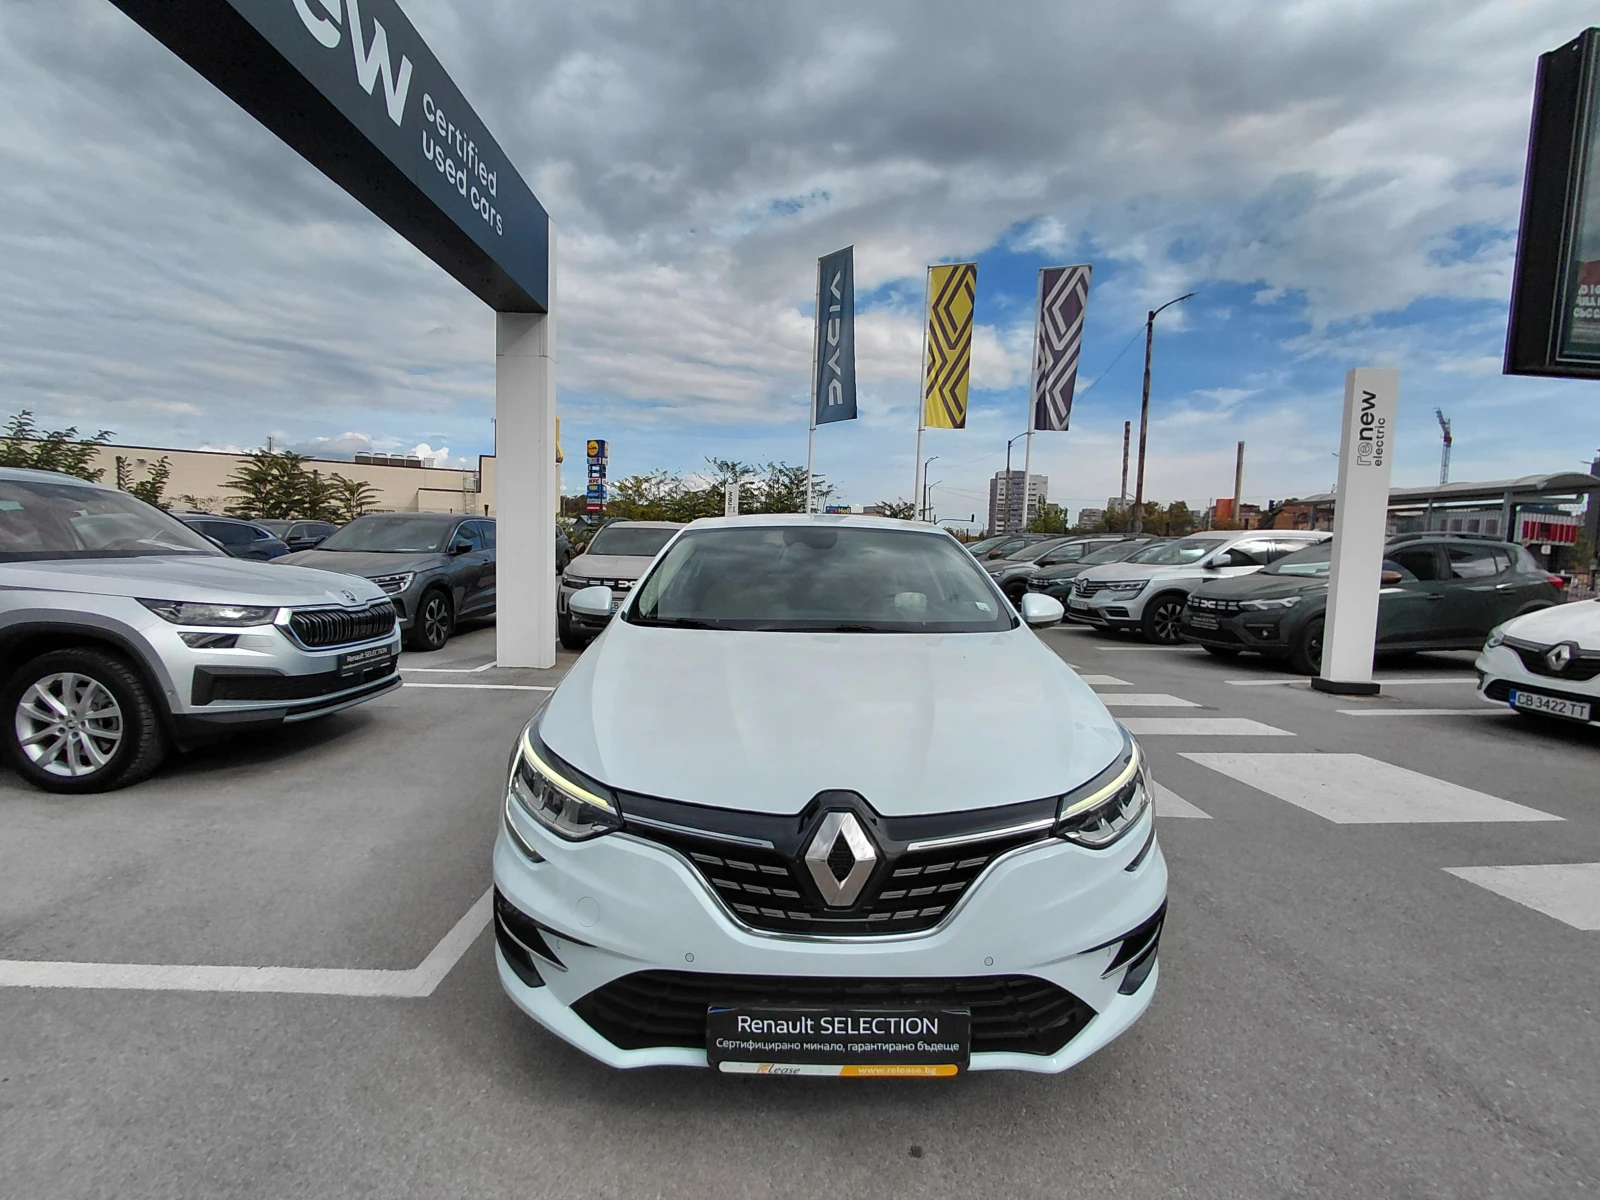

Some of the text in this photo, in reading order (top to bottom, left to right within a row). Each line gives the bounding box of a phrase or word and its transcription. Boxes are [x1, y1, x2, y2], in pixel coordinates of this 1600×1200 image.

[422, 92, 497, 198] certified
[422, 130, 503, 236] used cars
[1357, 390, 1377, 467] renew
[1373, 417, 1386, 467] electric
[346, 653, 364, 662] Renault
[365, 647, 388, 658] SELECTION
[1518, 694, 1586, 717] CB 3422 TT
[737, 1016, 938, 1034] Renault SELECTION
[716, 1038, 960, 1053] Сертифицирано минало, гарантирано бъдеще
[858, 1066, 937, 1076] www.release.bg
